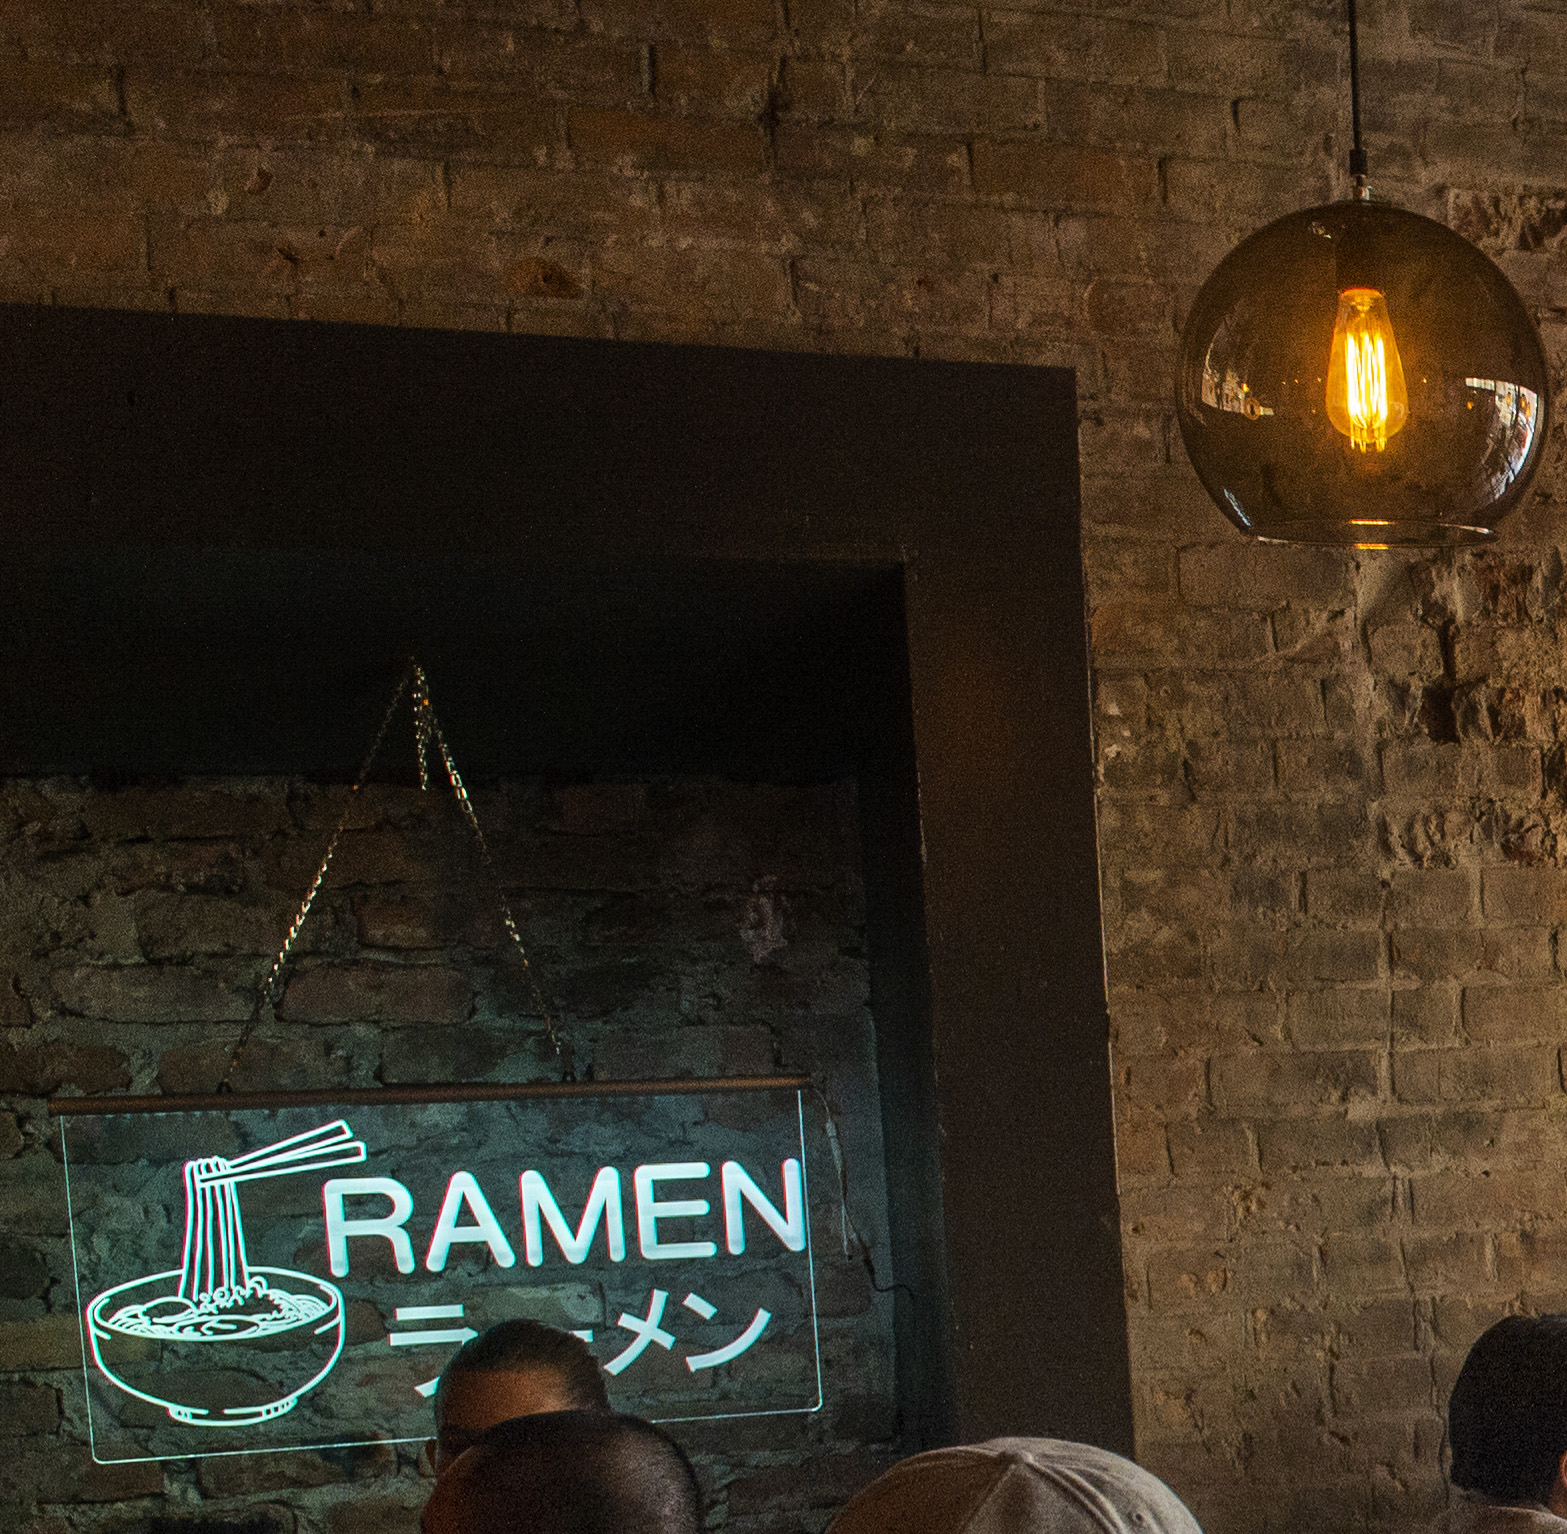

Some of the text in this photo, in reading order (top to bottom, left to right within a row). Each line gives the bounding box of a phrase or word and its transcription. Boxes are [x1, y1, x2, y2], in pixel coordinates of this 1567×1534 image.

[321, 1158, 807, 1277] RAMEN
[388, 1287, 772, 1398] ラメン
